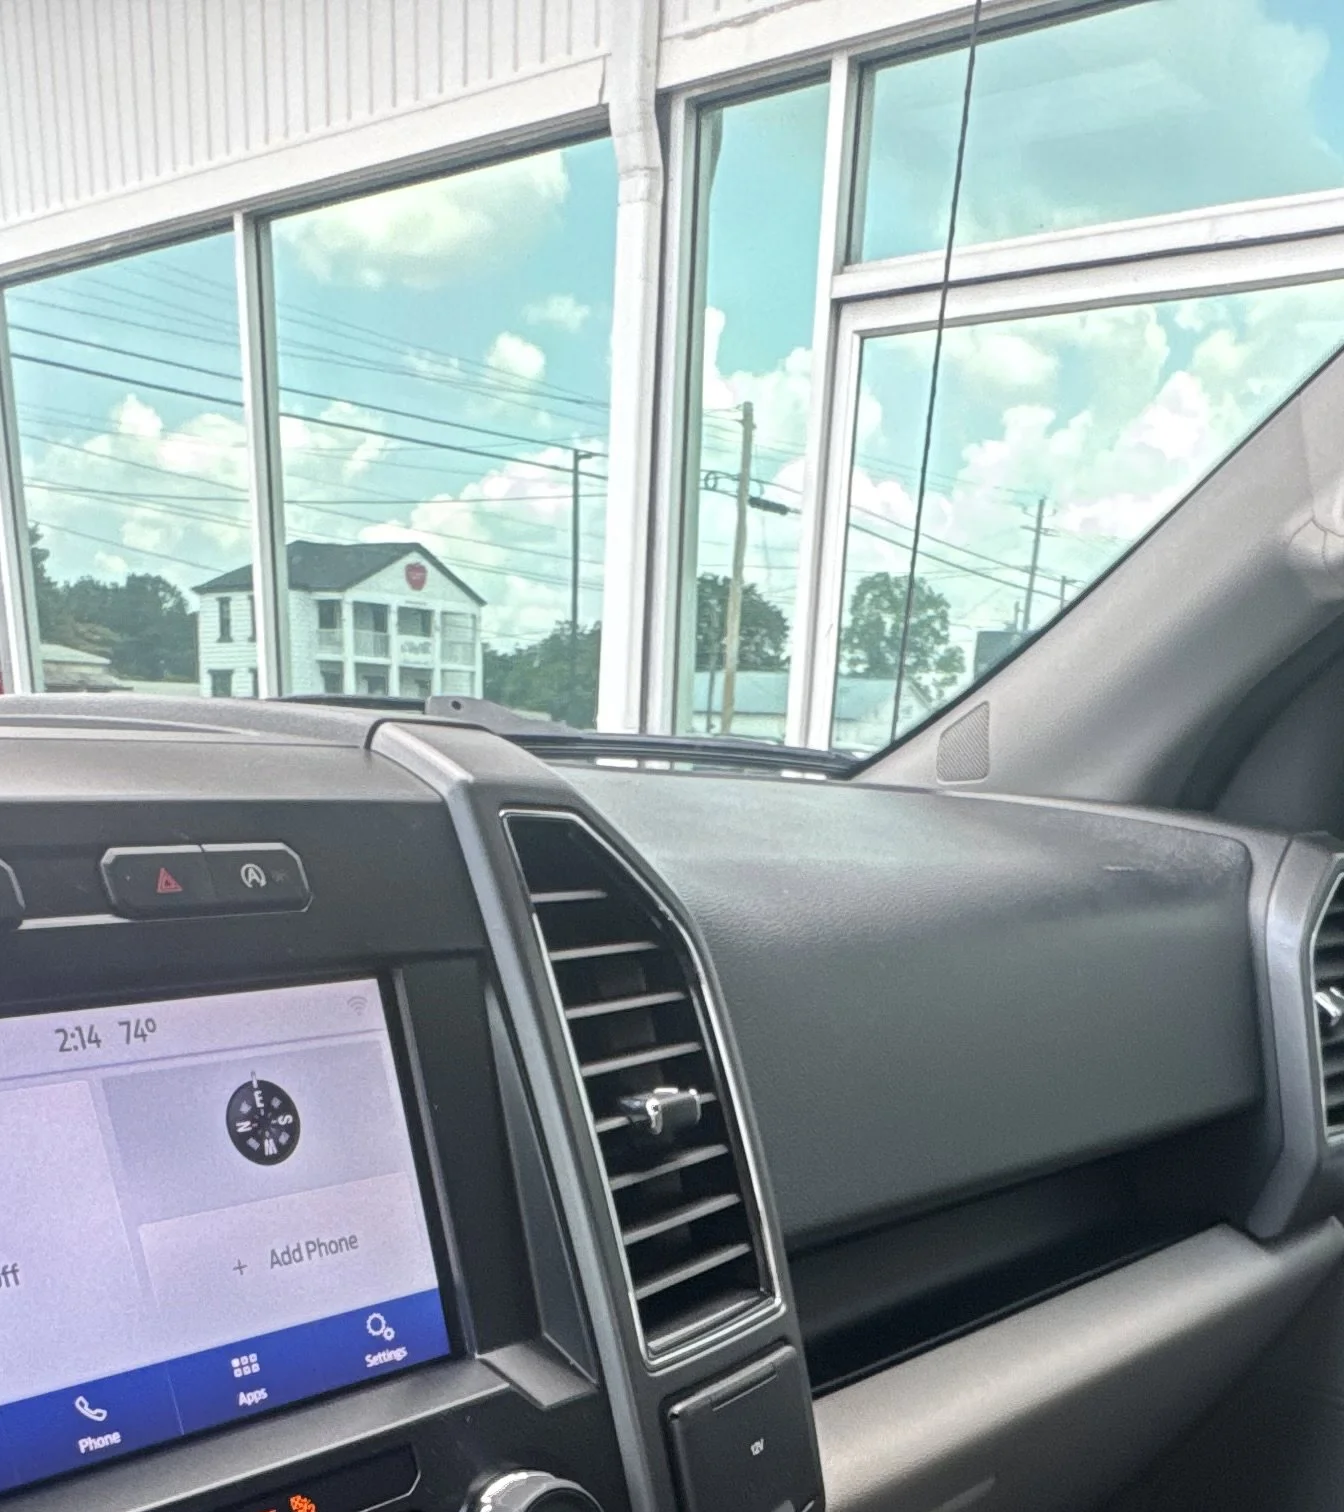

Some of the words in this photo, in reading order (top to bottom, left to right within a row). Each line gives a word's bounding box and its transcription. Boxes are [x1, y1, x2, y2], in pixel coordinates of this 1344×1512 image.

[54, 1027, 102, 1054] 2:14
[269, 1242, 304, 1270] Add
[305, 1233, 359, 1260] Phone
[364, 1346, 408, 1368] Settings
[237, 1387, 269, 1407] Apps
[78, 1429, 122, 1454] Phone
